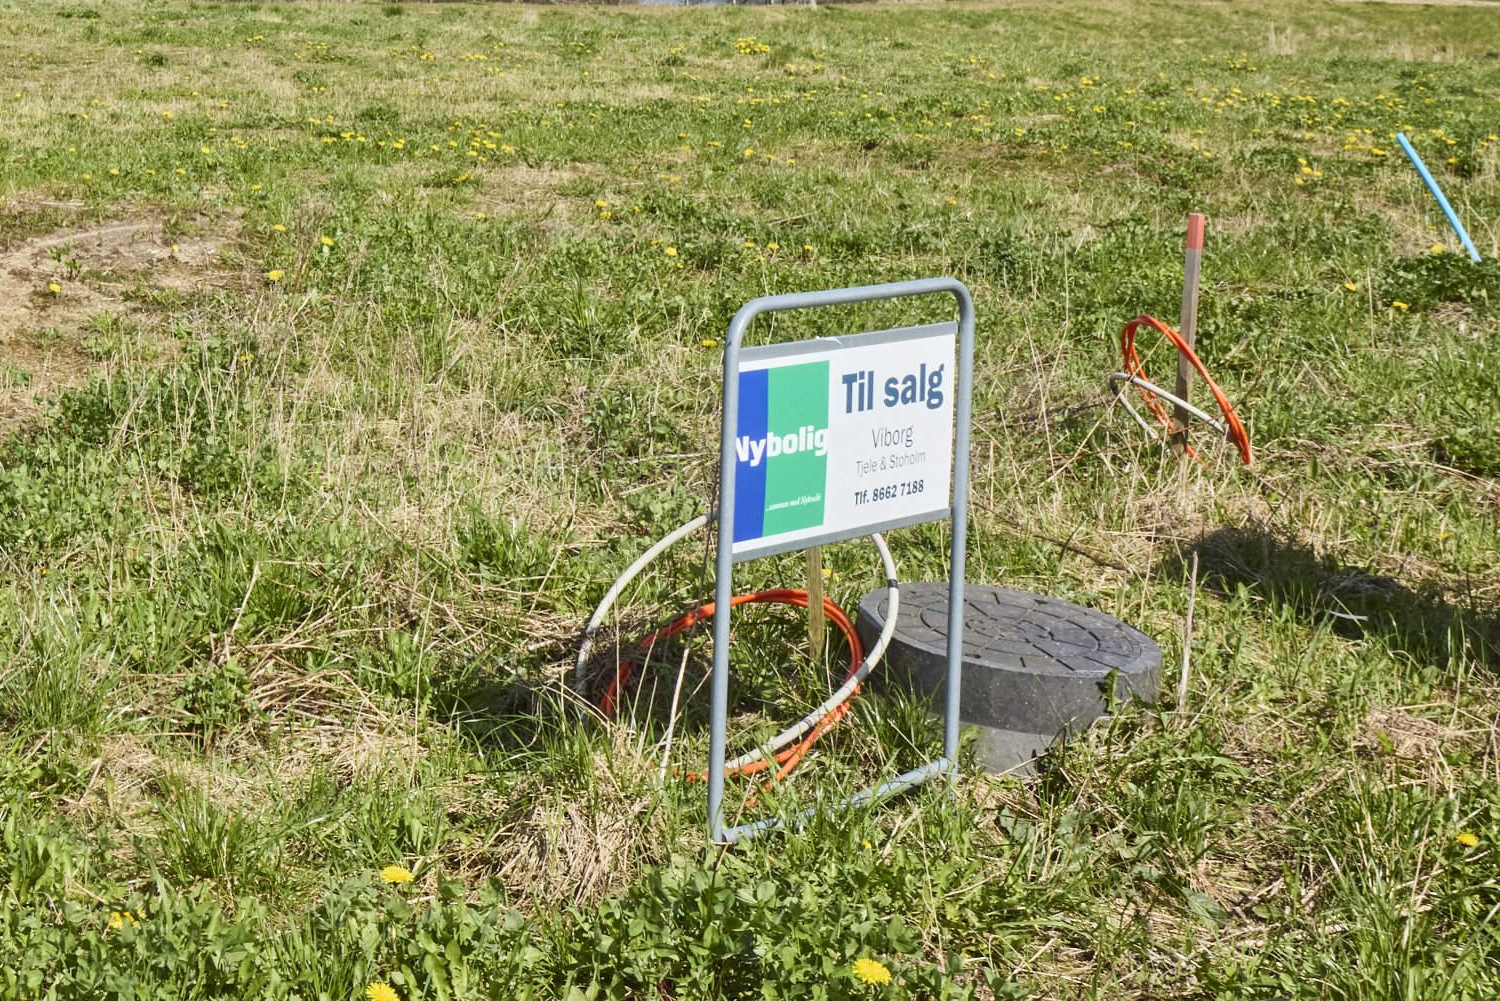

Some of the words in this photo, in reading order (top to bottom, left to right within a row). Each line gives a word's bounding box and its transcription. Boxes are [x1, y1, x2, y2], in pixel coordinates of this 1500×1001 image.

[842, 370, 874, 413] Til
[883, 363, 944, 410] salg
[872, 425, 914, 448] Viborg
[856, 459, 878, 477] Tjele
[880, 456, 887, 470] &
[889, 451, 926, 469] Stoholm
[854, 489, 870, 506] Tlf.
[872, 484, 898, 502] 8662
[900, 479, 924, 497] 7188
